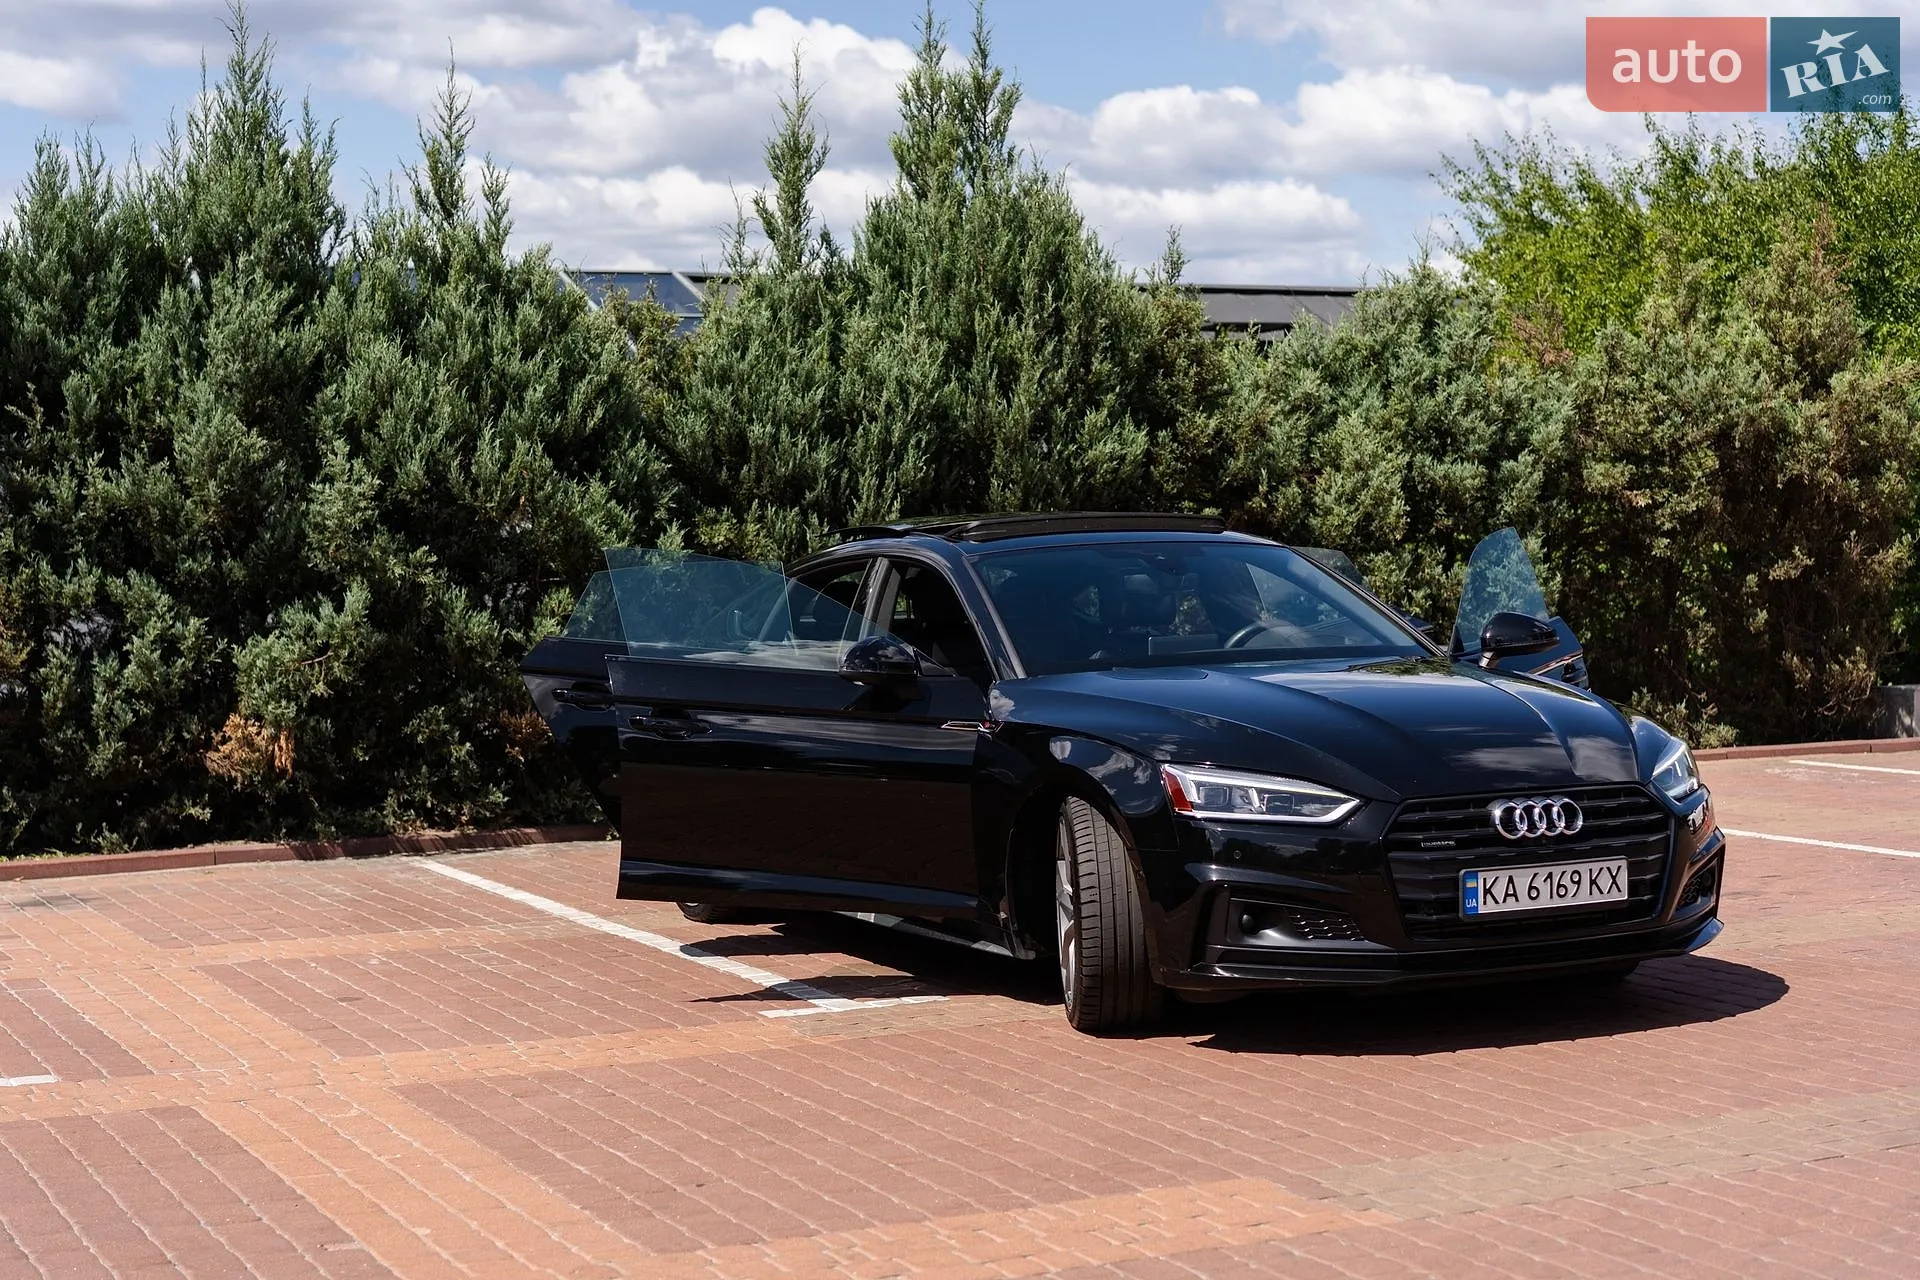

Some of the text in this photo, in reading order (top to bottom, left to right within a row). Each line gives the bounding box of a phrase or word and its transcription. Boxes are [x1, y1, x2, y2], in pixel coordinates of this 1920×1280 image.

[1482, 864, 1623, 906] KA 6169 KX
[1465, 897, 1478, 908] UA
